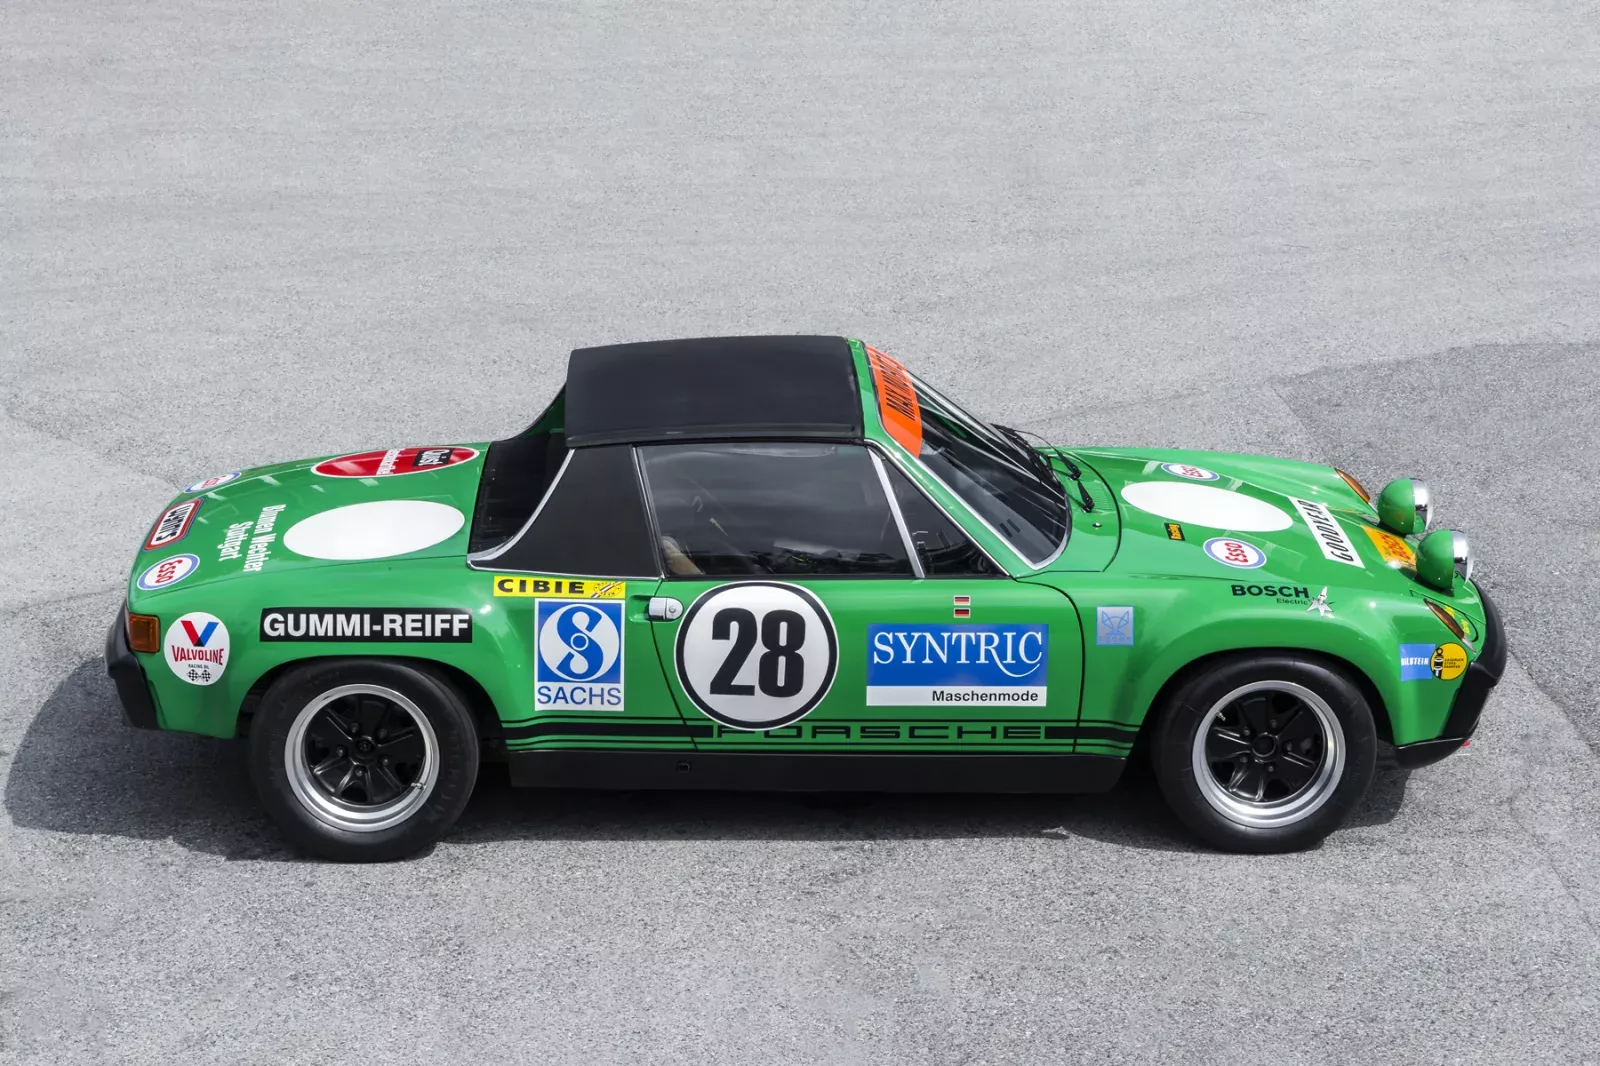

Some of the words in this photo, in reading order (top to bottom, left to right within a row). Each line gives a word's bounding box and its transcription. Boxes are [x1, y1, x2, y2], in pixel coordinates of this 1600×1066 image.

[217, 521, 254, 562] Stuttgart
[1296, 499, 1354, 562] GOODYEAR
[497, 578, 585, 594] CIBIE
[1231, 584, 1309, 598] BOSCH
[263, 612, 469, 638] GUMMI-REIFF
[171, 645, 225, 666] VALVOLINE
[709, 607, 806, 698] 28
[873, 631, 1042, 678] SYNTRIC
[537, 685, 622, 706] SACHS
[932, 690, 1038, 702] Maschenmode
